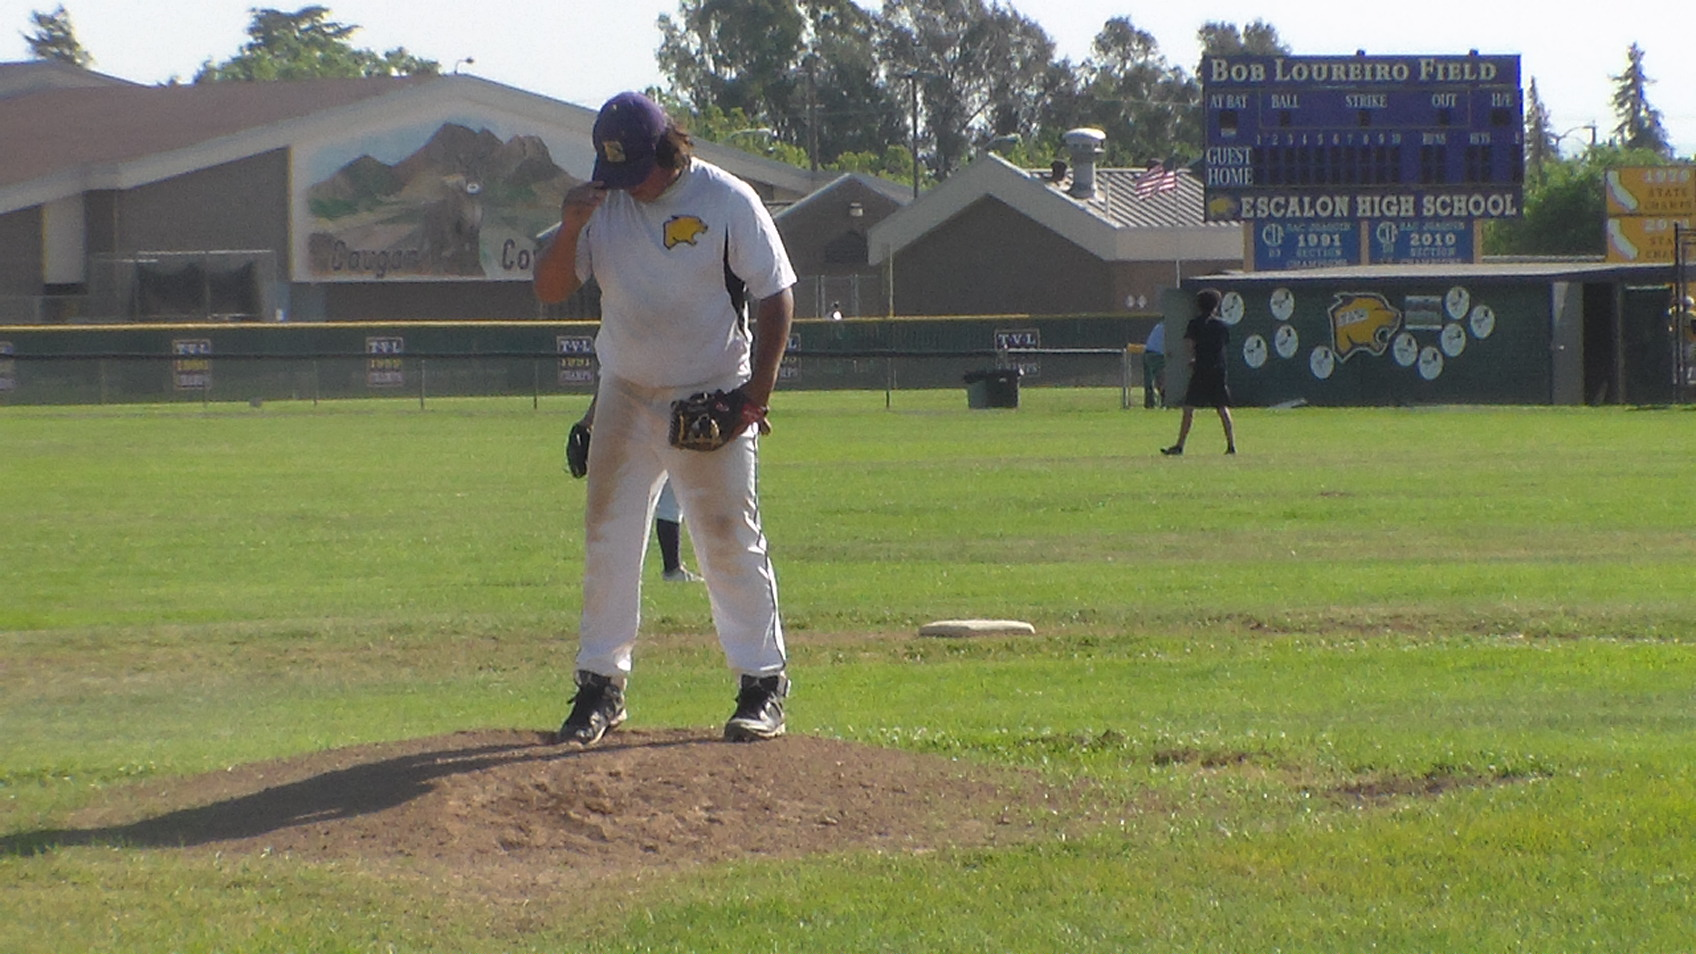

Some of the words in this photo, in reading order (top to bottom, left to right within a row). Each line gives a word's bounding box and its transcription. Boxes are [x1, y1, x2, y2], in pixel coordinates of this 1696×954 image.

[1210, 94, 1224, 109] AT
[1226, 94, 1248, 109] BAT
[1271, 94, 1299, 109] BALL
[1345, 94, 1387, 109] STRIKE
[1431, 93, 1457, 108] OUT
[1206, 147, 1252, 166] GUEST
[1207, 167, 1253, 186] HOME
[1240, 195, 1350, 218] ESCALON
[1356, 195, 1415, 218] HIGH
[1422, 193, 1517, 217] SCHOOL
[1409, 232, 1456, 246] 2010
